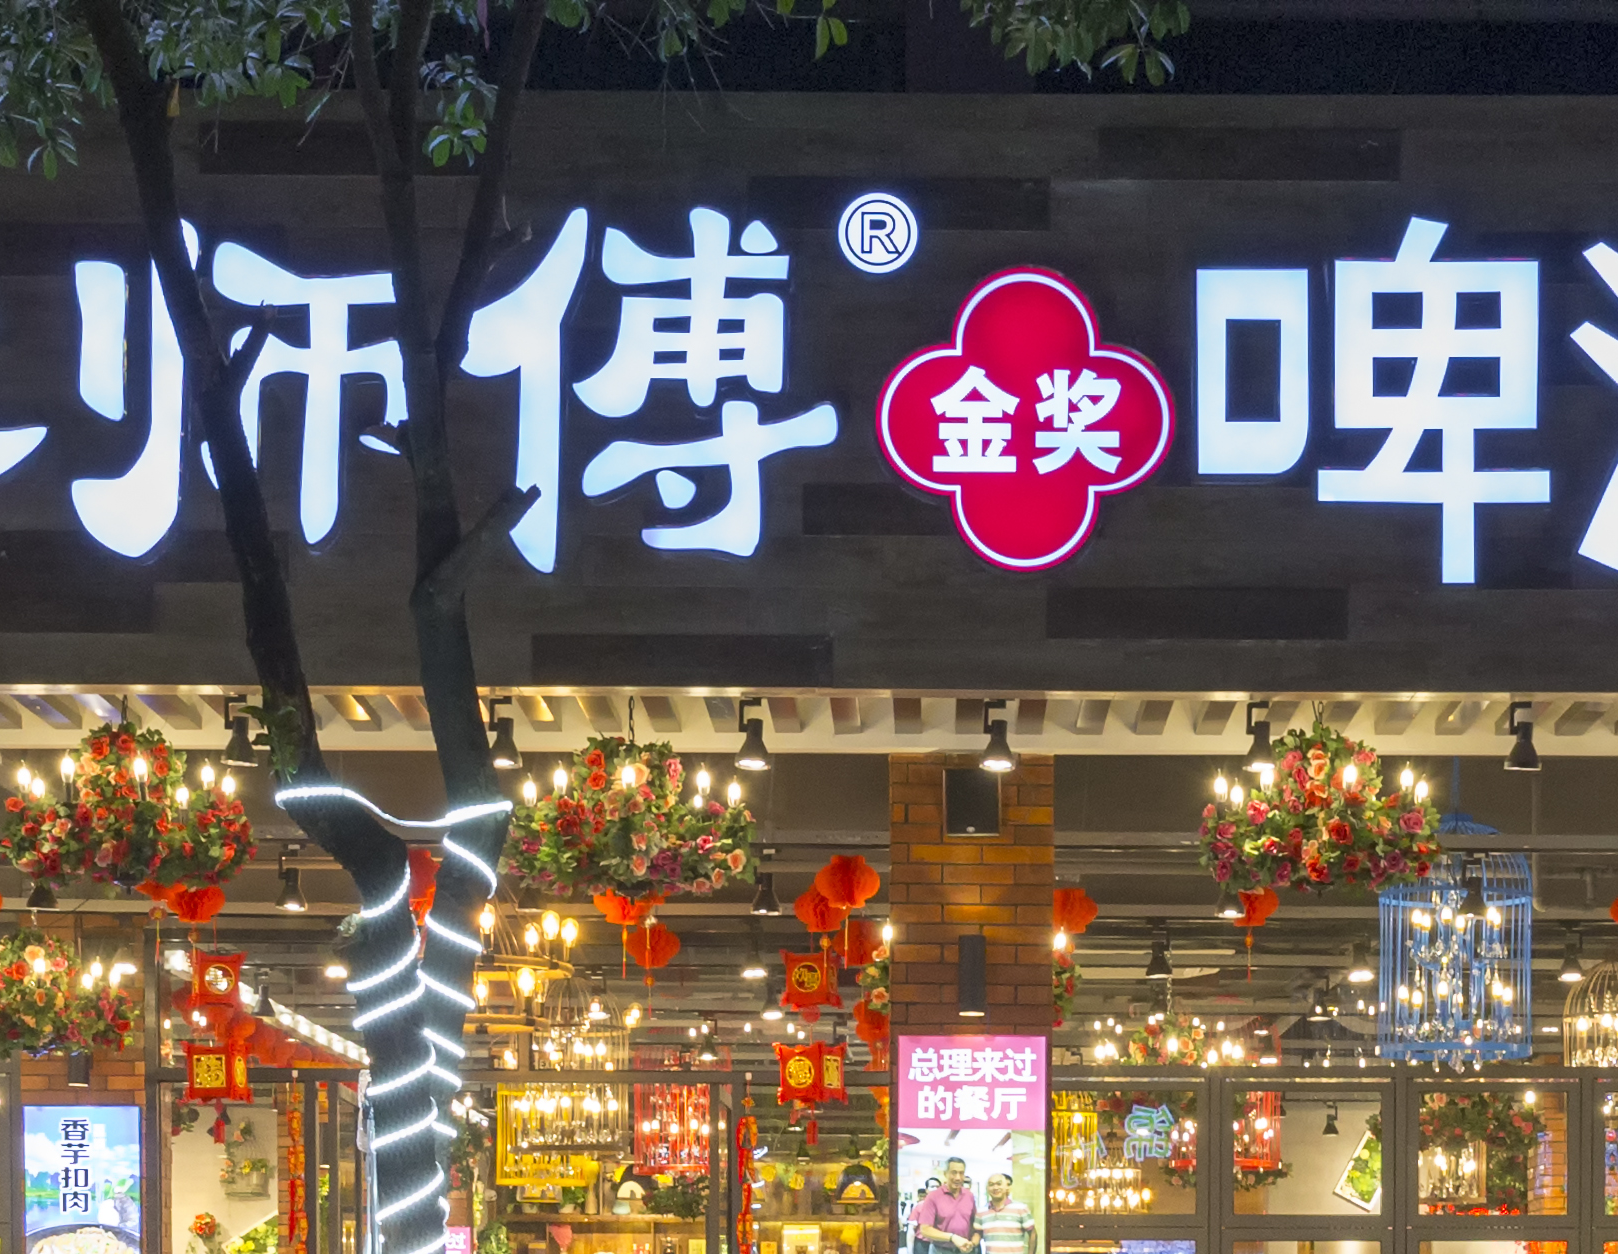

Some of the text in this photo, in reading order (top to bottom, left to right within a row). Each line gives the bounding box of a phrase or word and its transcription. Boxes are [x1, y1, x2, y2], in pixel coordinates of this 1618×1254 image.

[929, 364, 1124, 476] 金奖
[908, 1047, 1037, 1083] 总理来过
[917, 1085, 1027, 1121] 的餐厅
[61, 1119, 90, 1213] 香芋扣肉
